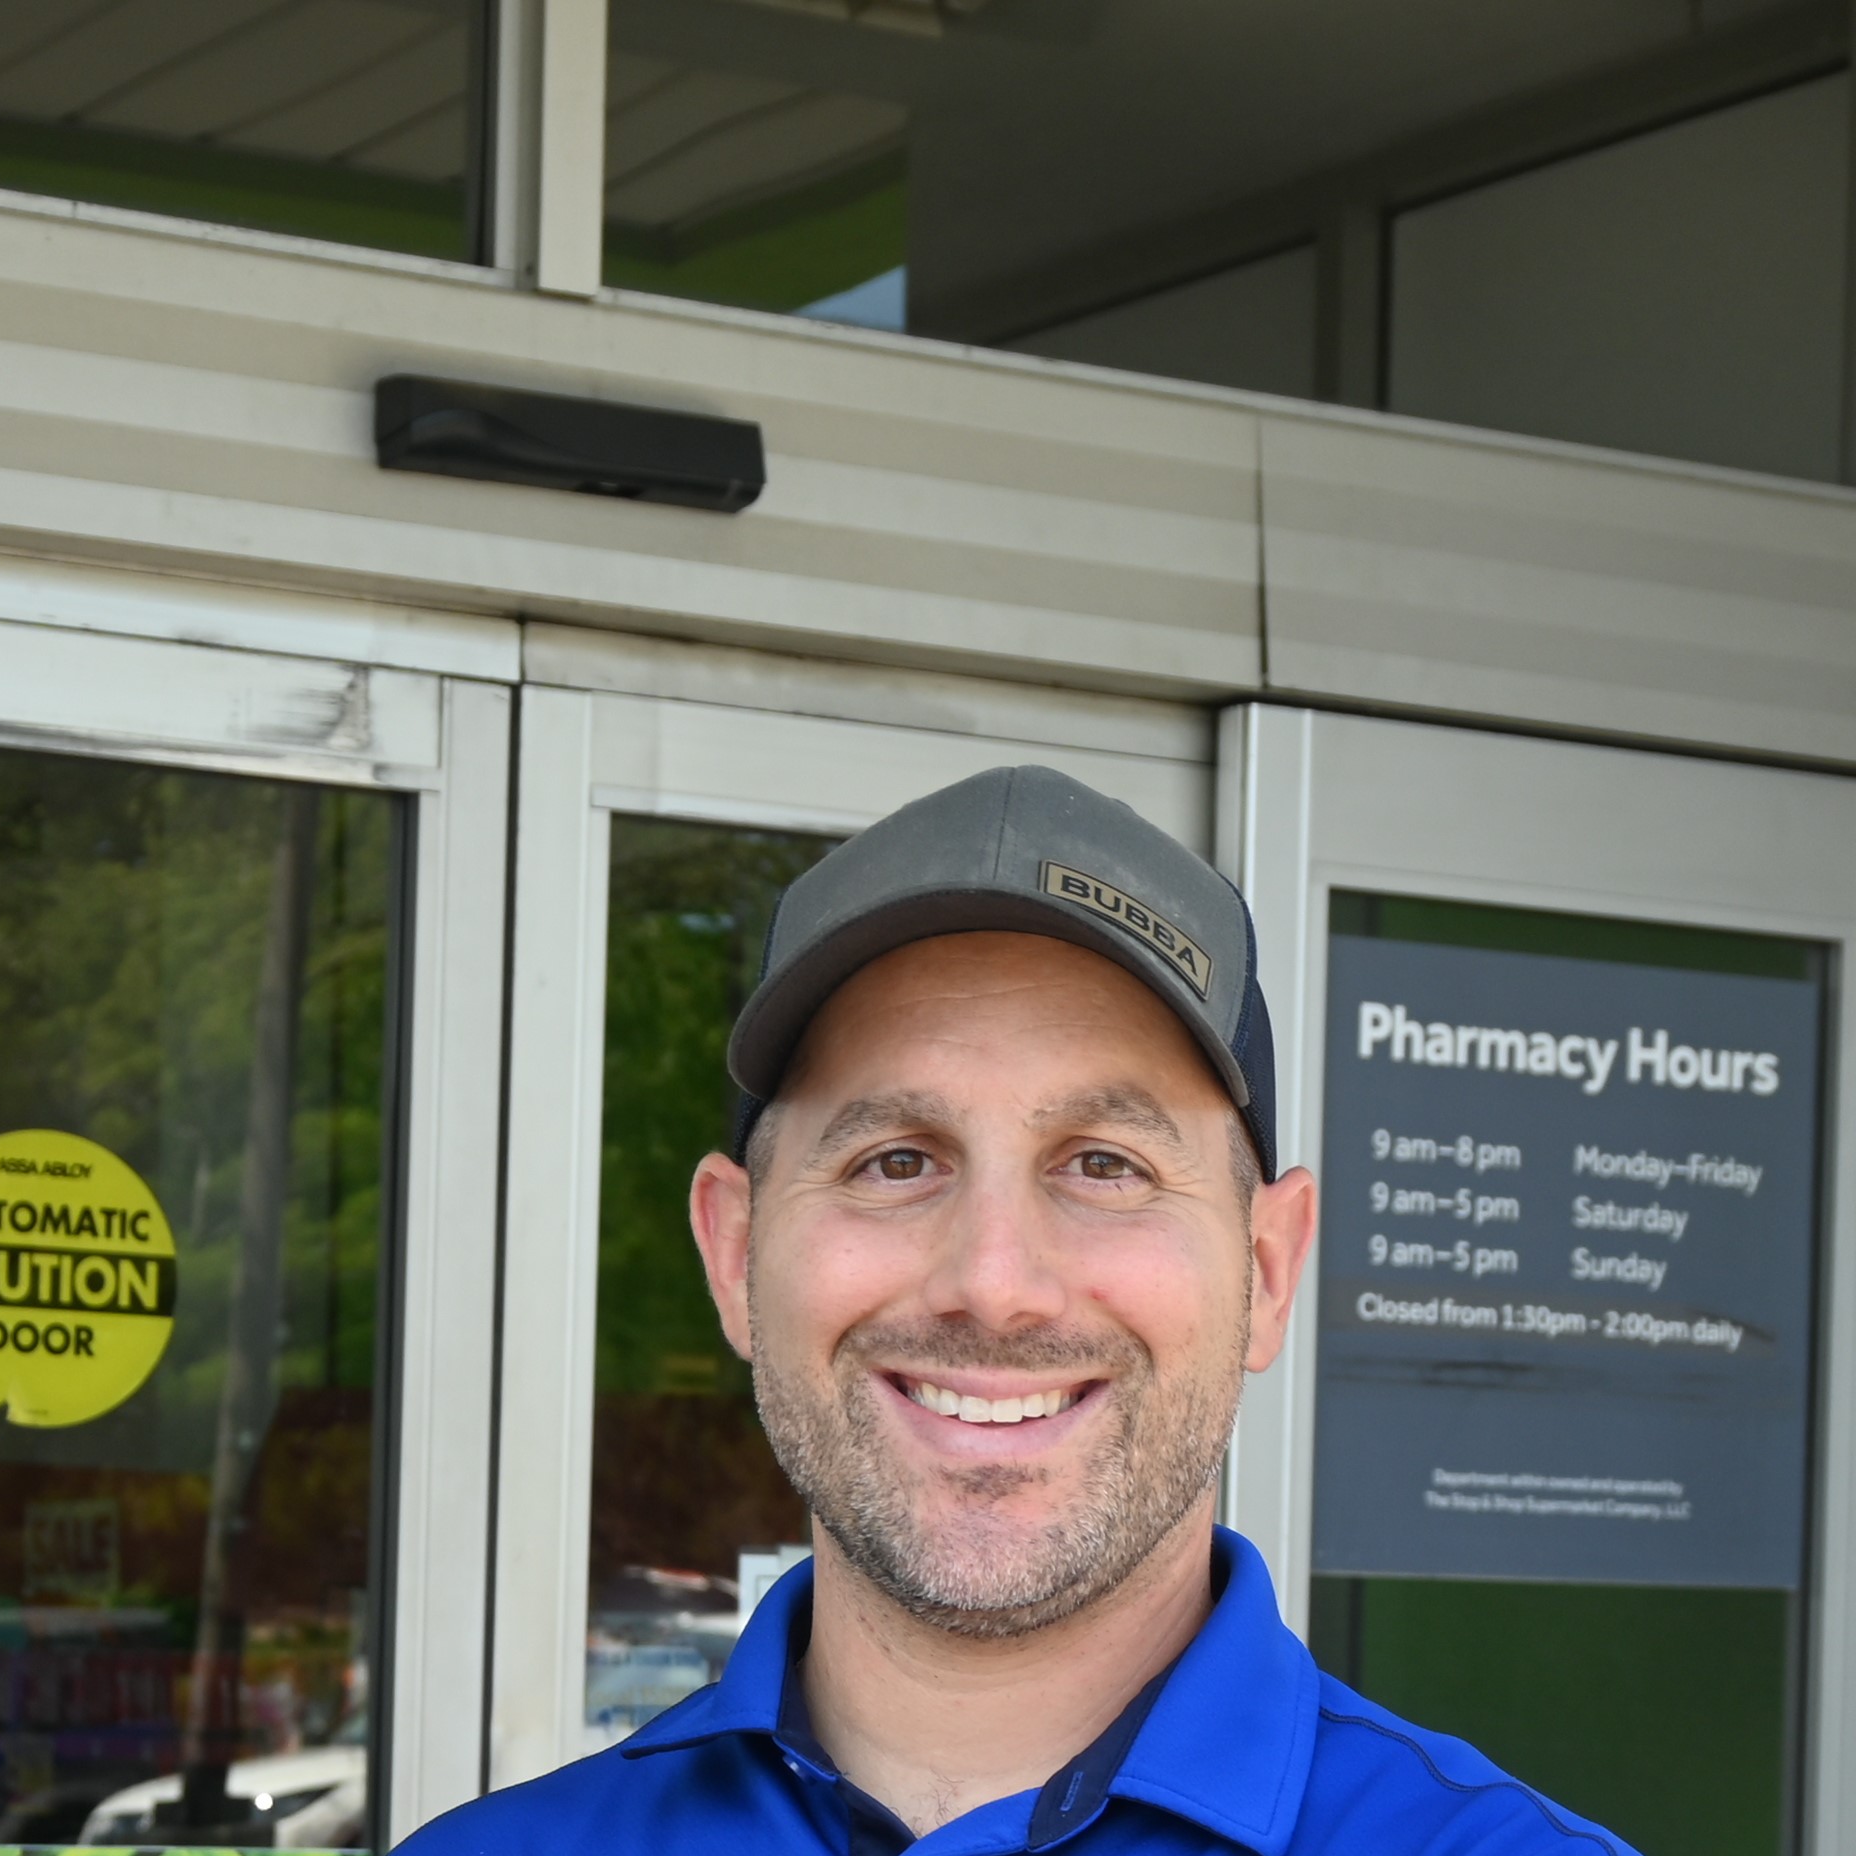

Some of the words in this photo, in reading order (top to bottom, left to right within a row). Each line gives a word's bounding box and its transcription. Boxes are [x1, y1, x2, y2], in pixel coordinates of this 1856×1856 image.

[1060, 874, 1199, 977] BUBBA
[1358, 1001, 1617, 1094] Pharmacy
[1626, 1028, 1779, 1095] Hours
[42, 1161, 92, 1178] ABLOY
[1372, 1130, 1391, 1159] 9
[1478, 1145, 1521, 1173] pm
[1370, 1183, 1390, 1212] 9
[1475, 1197, 1519, 1225] pm
[1573, 1196, 1688, 1239] Saturday
[1368, 1236, 1389, 1264] 9
[1474, 1249, 1518, 1277] pm
[1571, 1248, 1666, 1290] Sunday
[1357, 1292, 1439, 1325] Closed
[1443, 1298, 1497, 1328] from
[1503, 1304, 1586, 1337] 1:30pm
[1604, 1311, 1688, 1342] 2:00pm
[1692, 1317, 1744, 1352] daily
